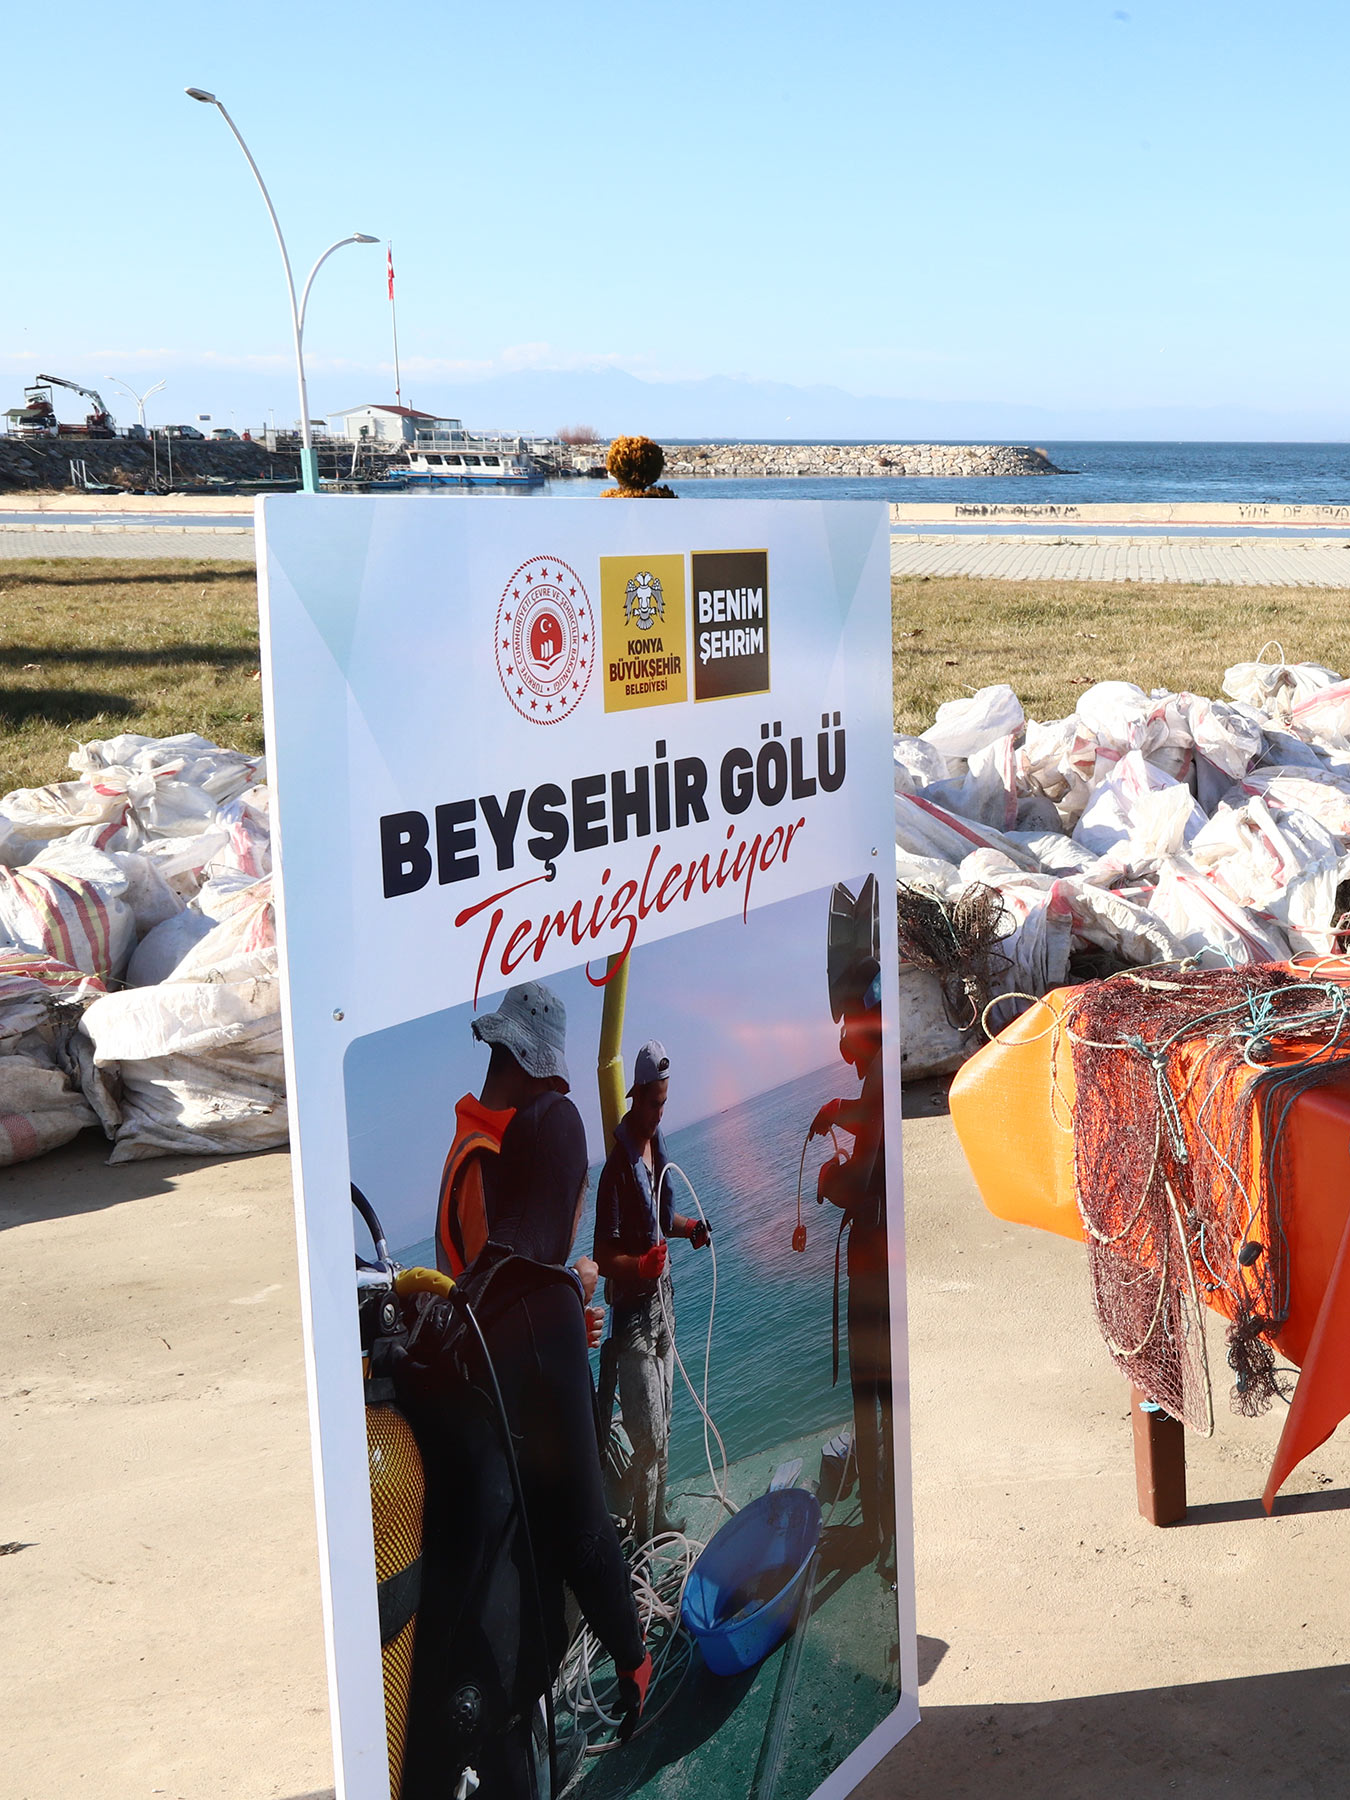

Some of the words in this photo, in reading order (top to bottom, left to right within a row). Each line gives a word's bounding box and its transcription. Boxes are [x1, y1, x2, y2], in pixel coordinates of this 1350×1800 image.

[530, 587, 551, 602] ÇEVRE
[552, 589, 561, 601] VE
[698, 587, 763, 624] BENİM
[627, 637, 664, 656] KONYA
[699, 626, 764, 666] ŞEHRİM
[609, 652, 682, 682] BÜYÜKŞEHİR
[625, 677, 668, 696] BELEDİYESİ
[380, 740, 709, 899] BEYŞEHİR
[720, 711, 847, 815] GÖLÜ
[454, 816, 806, 1012] Temizleniyor
